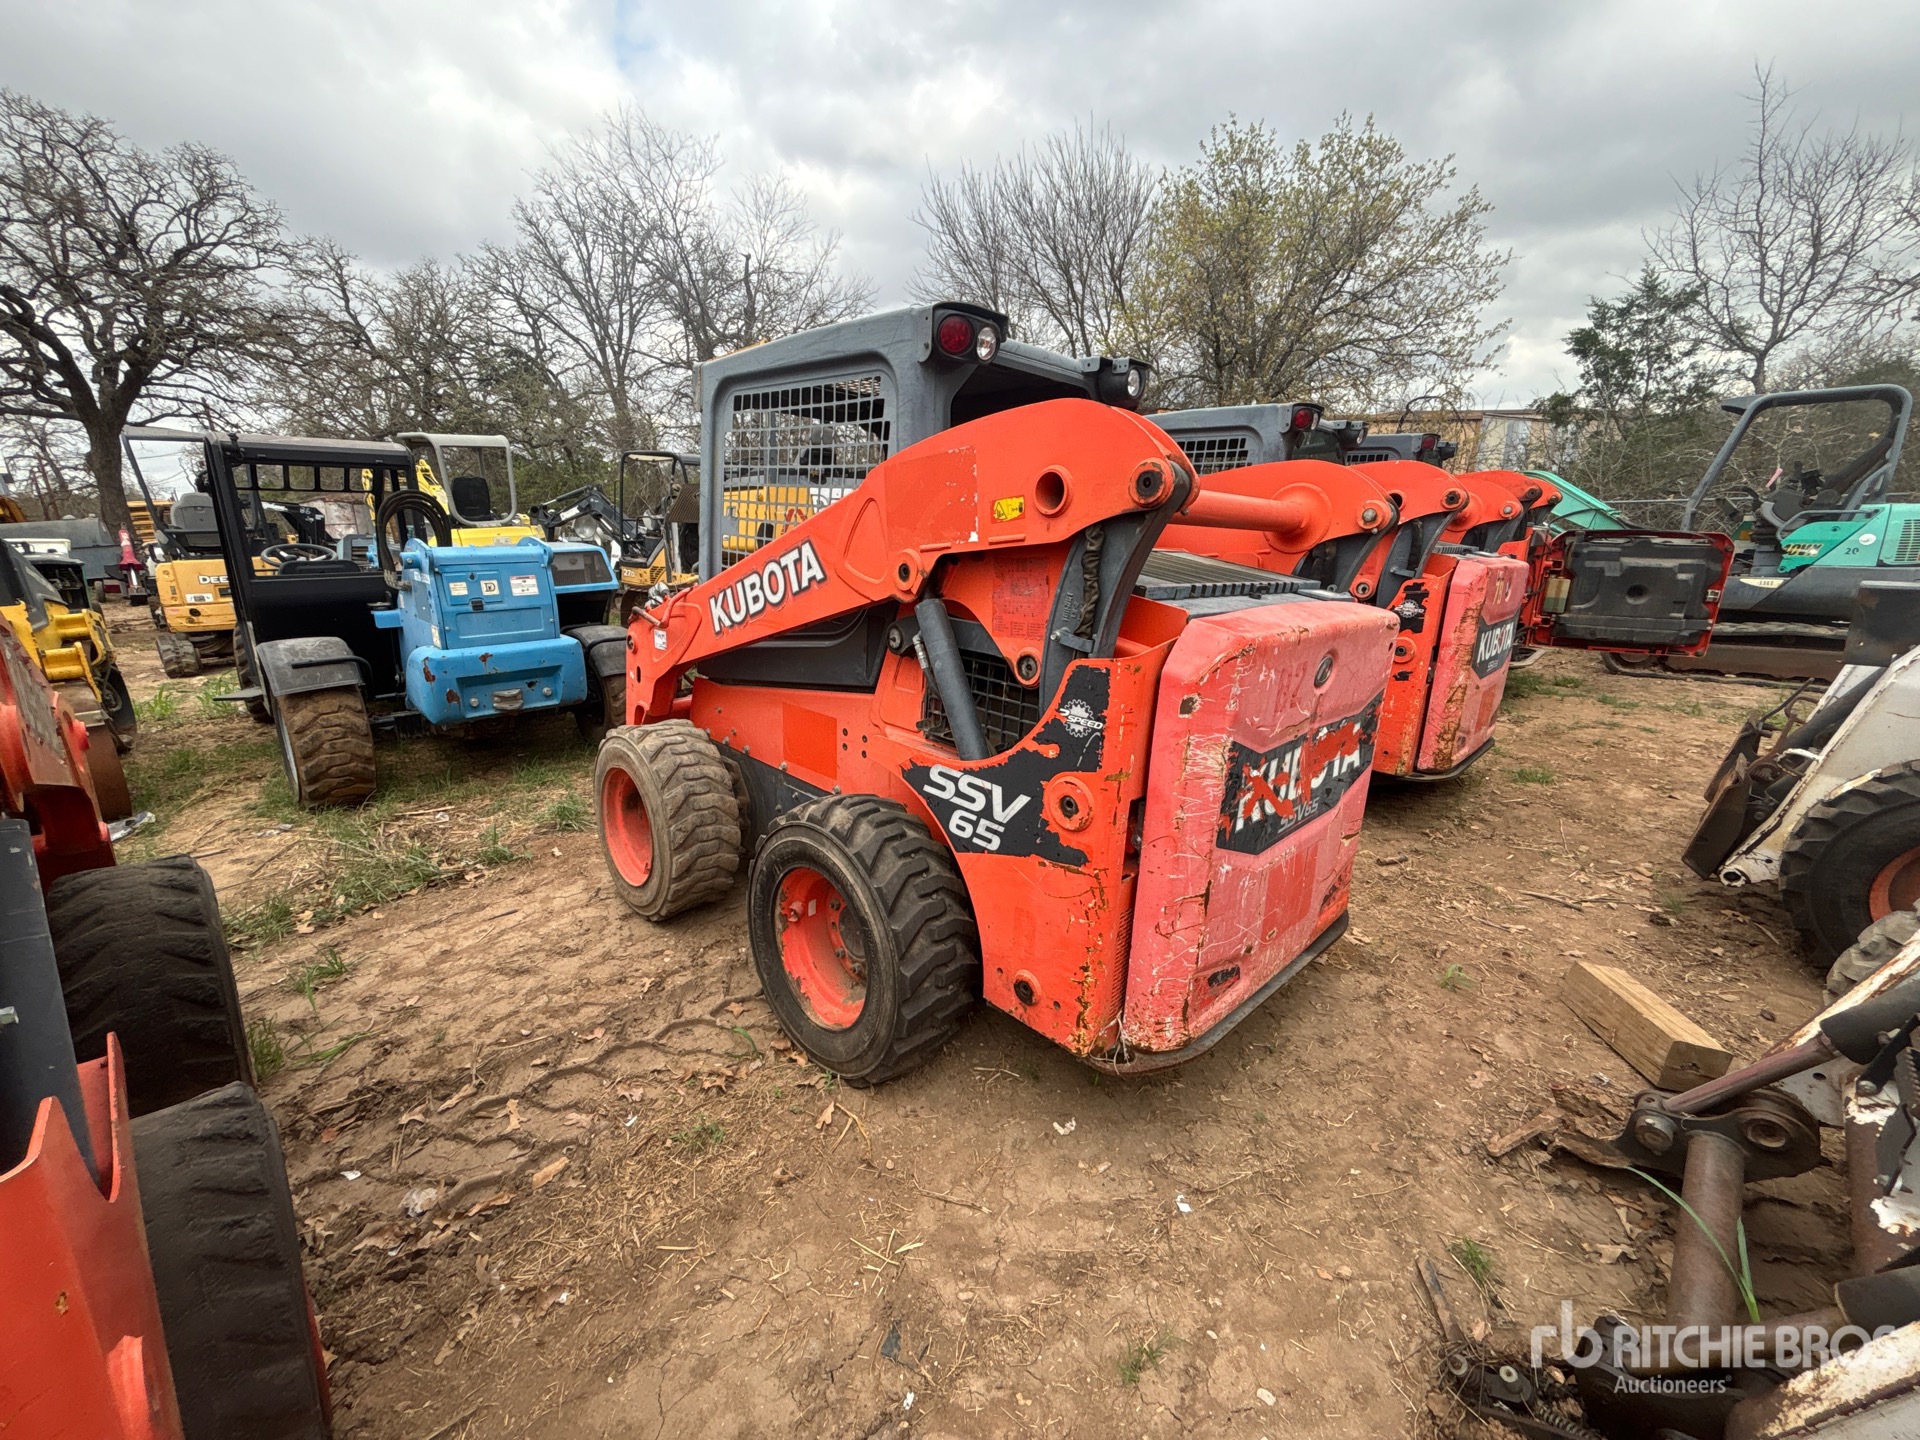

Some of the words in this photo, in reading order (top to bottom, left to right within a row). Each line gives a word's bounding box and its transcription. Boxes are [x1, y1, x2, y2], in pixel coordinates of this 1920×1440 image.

[709, 540, 827, 634] KUBOTA
[1477, 621, 1515, 663] KUBOTA
[922, 763, 1032, 824] SSV
[948, 809, 1006, 851] 65
